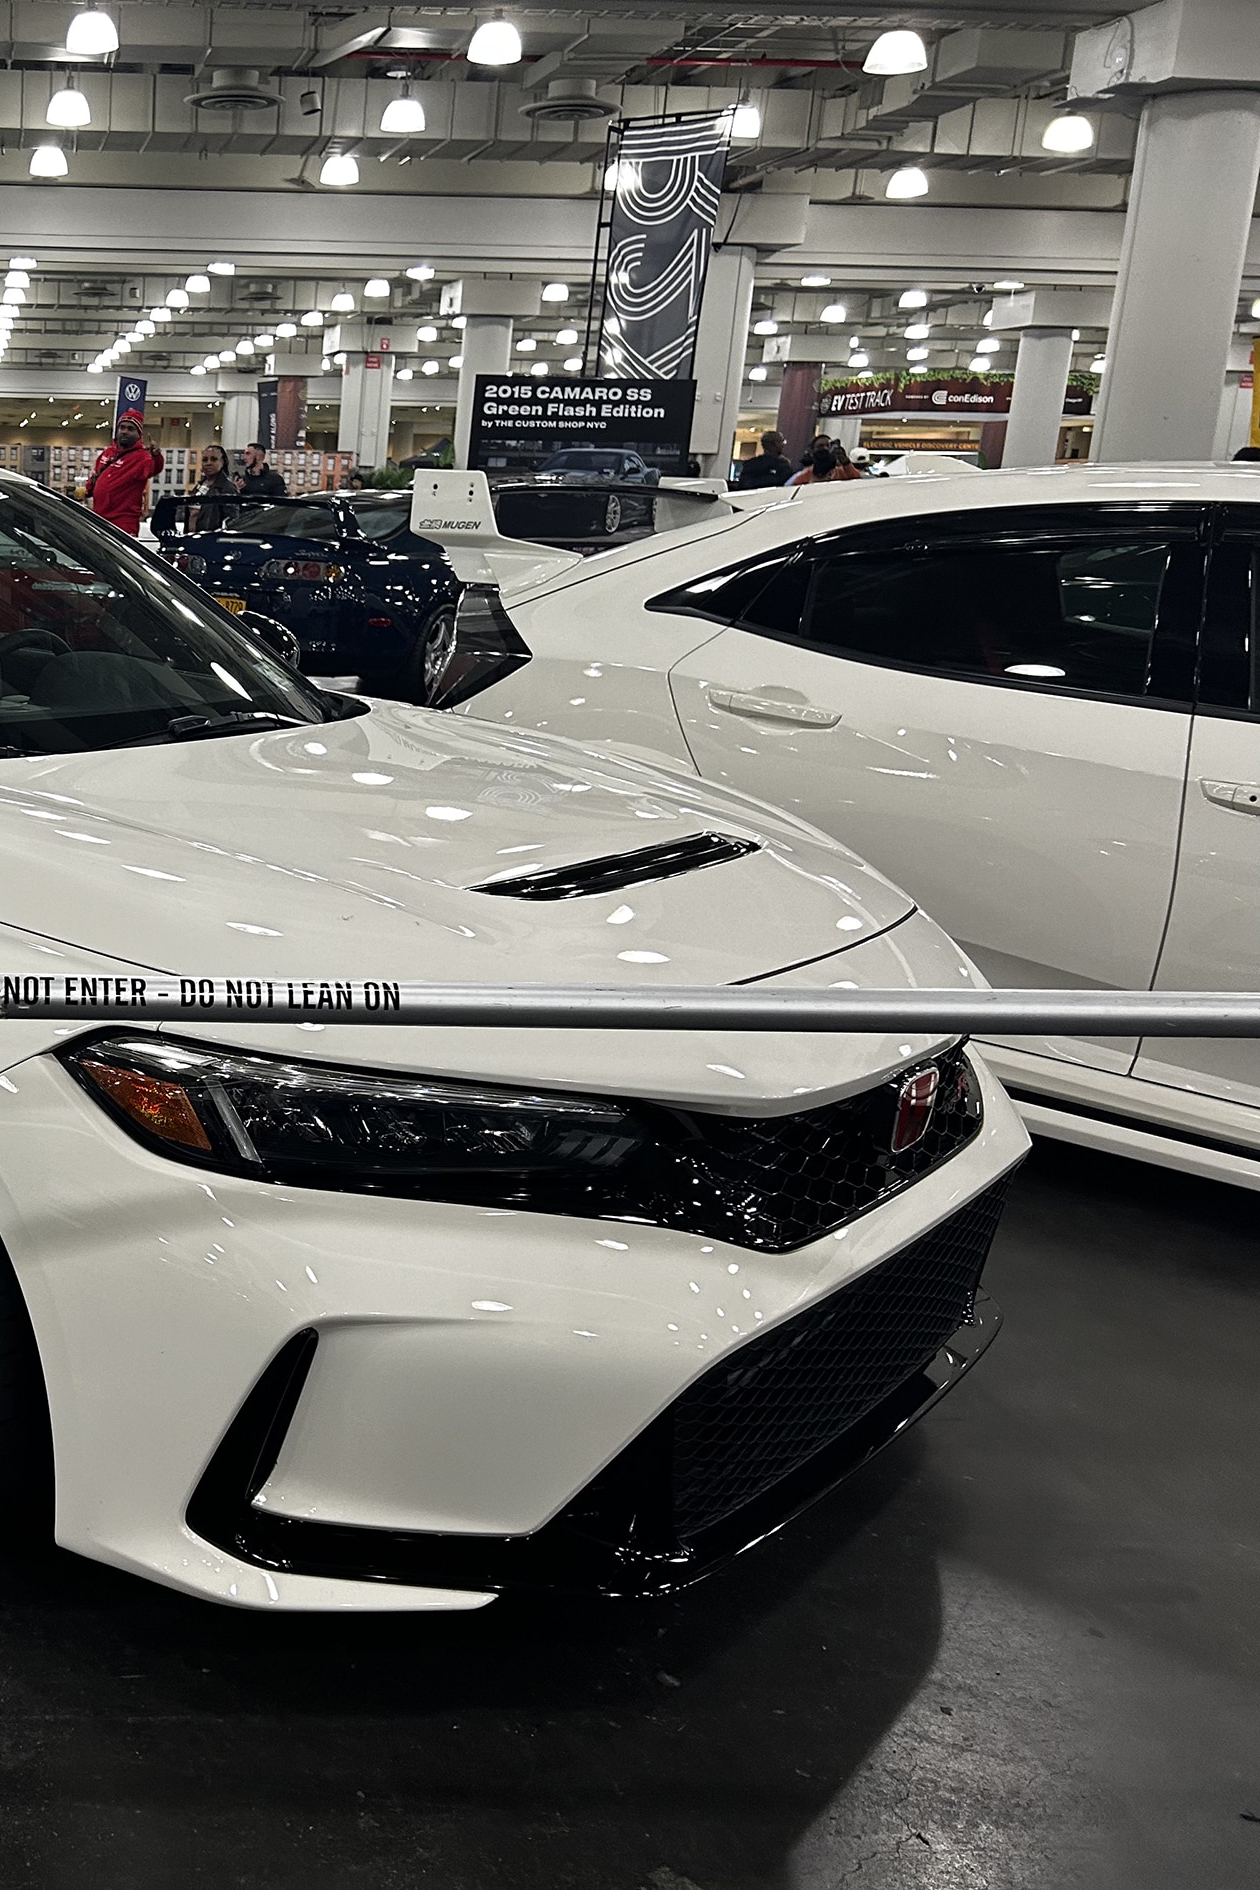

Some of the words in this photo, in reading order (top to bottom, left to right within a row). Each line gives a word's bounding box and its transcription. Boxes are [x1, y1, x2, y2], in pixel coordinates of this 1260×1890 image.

[484, 385, 533, 399] 2015
[536, 386, 623, 401] CAMARO
[625, 387, 653, 401] SS
[948, 393, 994, 404] conEdison
[831, 394, 845, 412] EV
[844, 391, 866, 410] TEST
[864, 388, 894, 409] TRACK
[483, 402, 543, 416] Green
[546, 403, 597, 417] Flash
[600, 404, 666, 419] Edition
[481, 419, 493, 429] by
[494, 419, 514, 428] THE
[515, 420, 557, 429] CUSTOM
[558, 421, 586, 429] SHOP
[586, 421, 608, 430] NYC
[863, 440, 893, 449] ELECTRIC
[893, 441, 920, 450] VEHICLE
[921, 441, 958, 450] DISCOVERY
[442, 520, 482, 530] MUGEN
[3, 976, 55, 1006] NOT
[64, 977, 147, 1007] ENTER
[180, 979, 215, 1008] DO
[226, 979, 277, 1010] NOT
[287, 981, 353, 1012] LEAN
[363, 981, 401, 1012] ON
